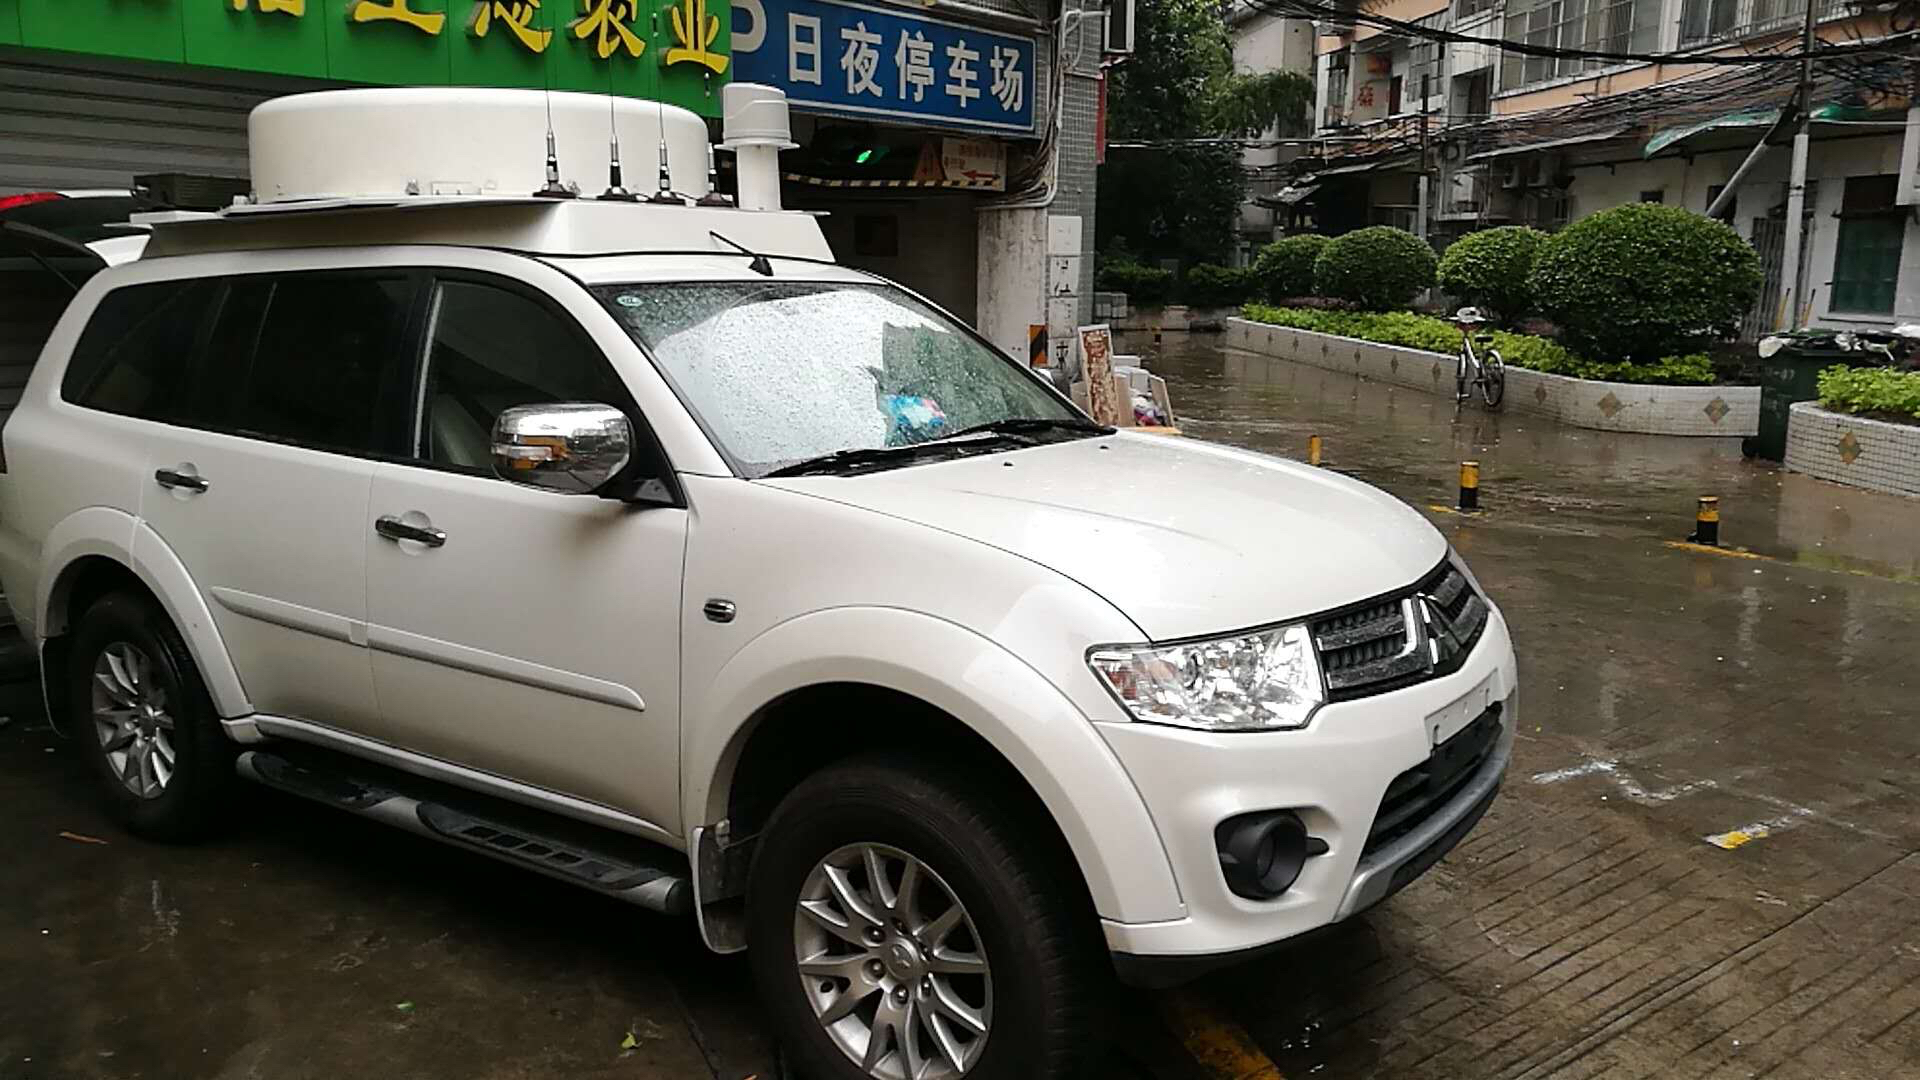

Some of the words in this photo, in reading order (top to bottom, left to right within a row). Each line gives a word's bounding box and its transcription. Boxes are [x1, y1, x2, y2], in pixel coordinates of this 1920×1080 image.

[788, 13, 1023, 112] 日夜停车场
